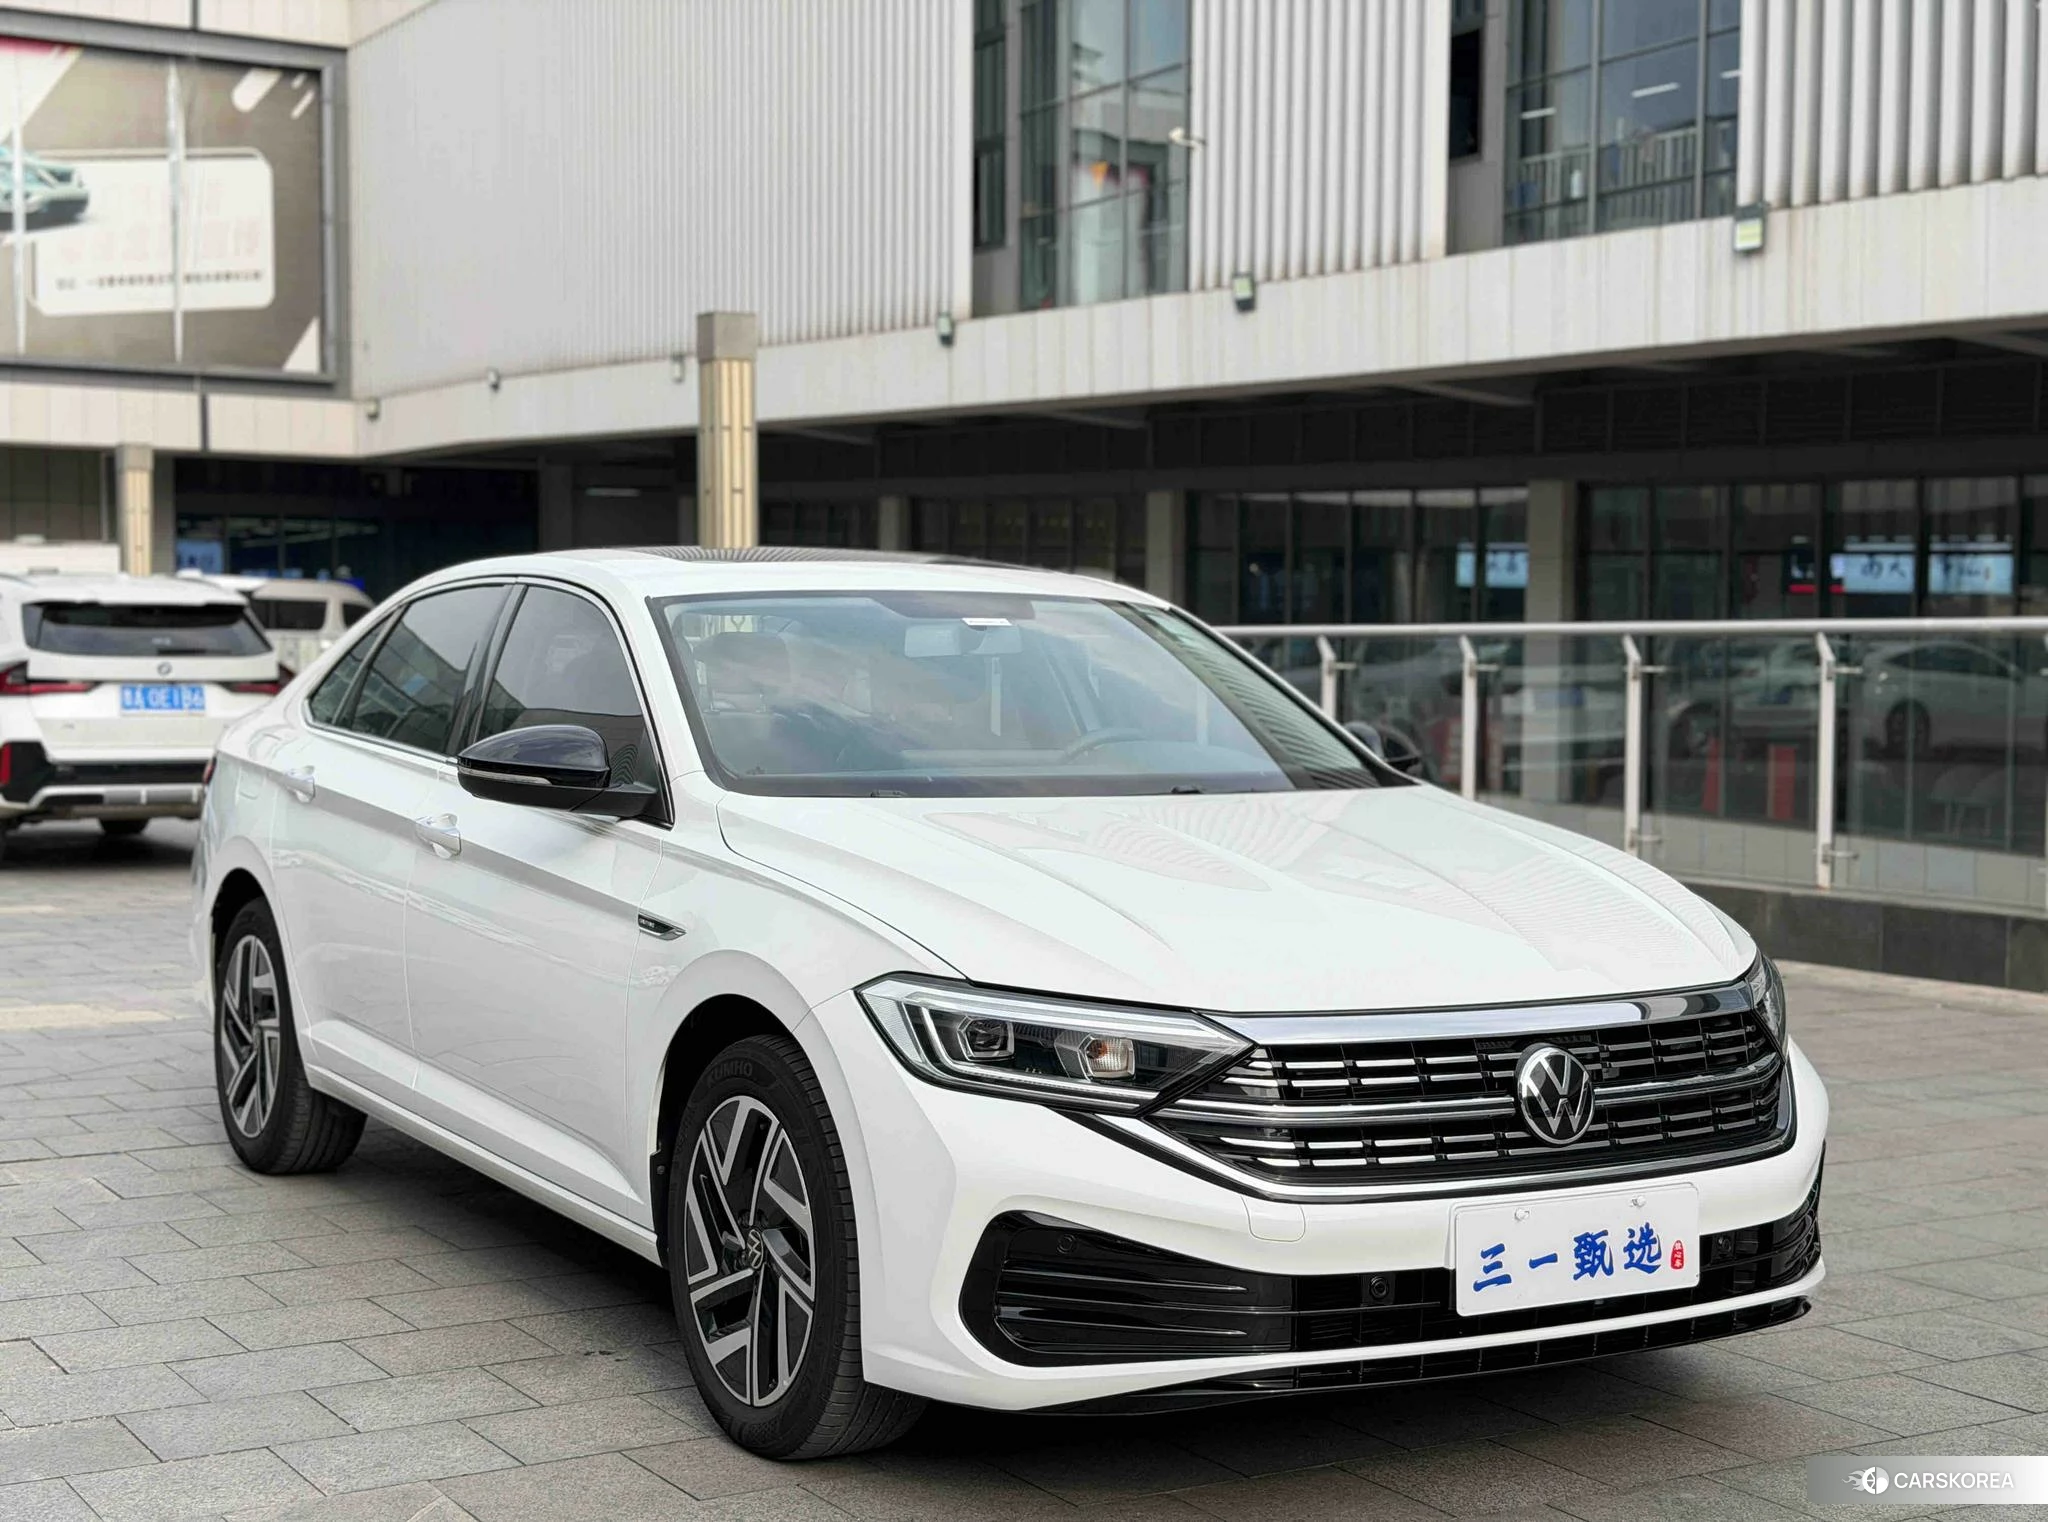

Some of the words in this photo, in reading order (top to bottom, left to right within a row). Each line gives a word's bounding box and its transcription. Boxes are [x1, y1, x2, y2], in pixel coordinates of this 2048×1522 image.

[706, 1060, 753, 1088] KUMHO
[1473, 1222, 1662, 1292] 三一甄选
